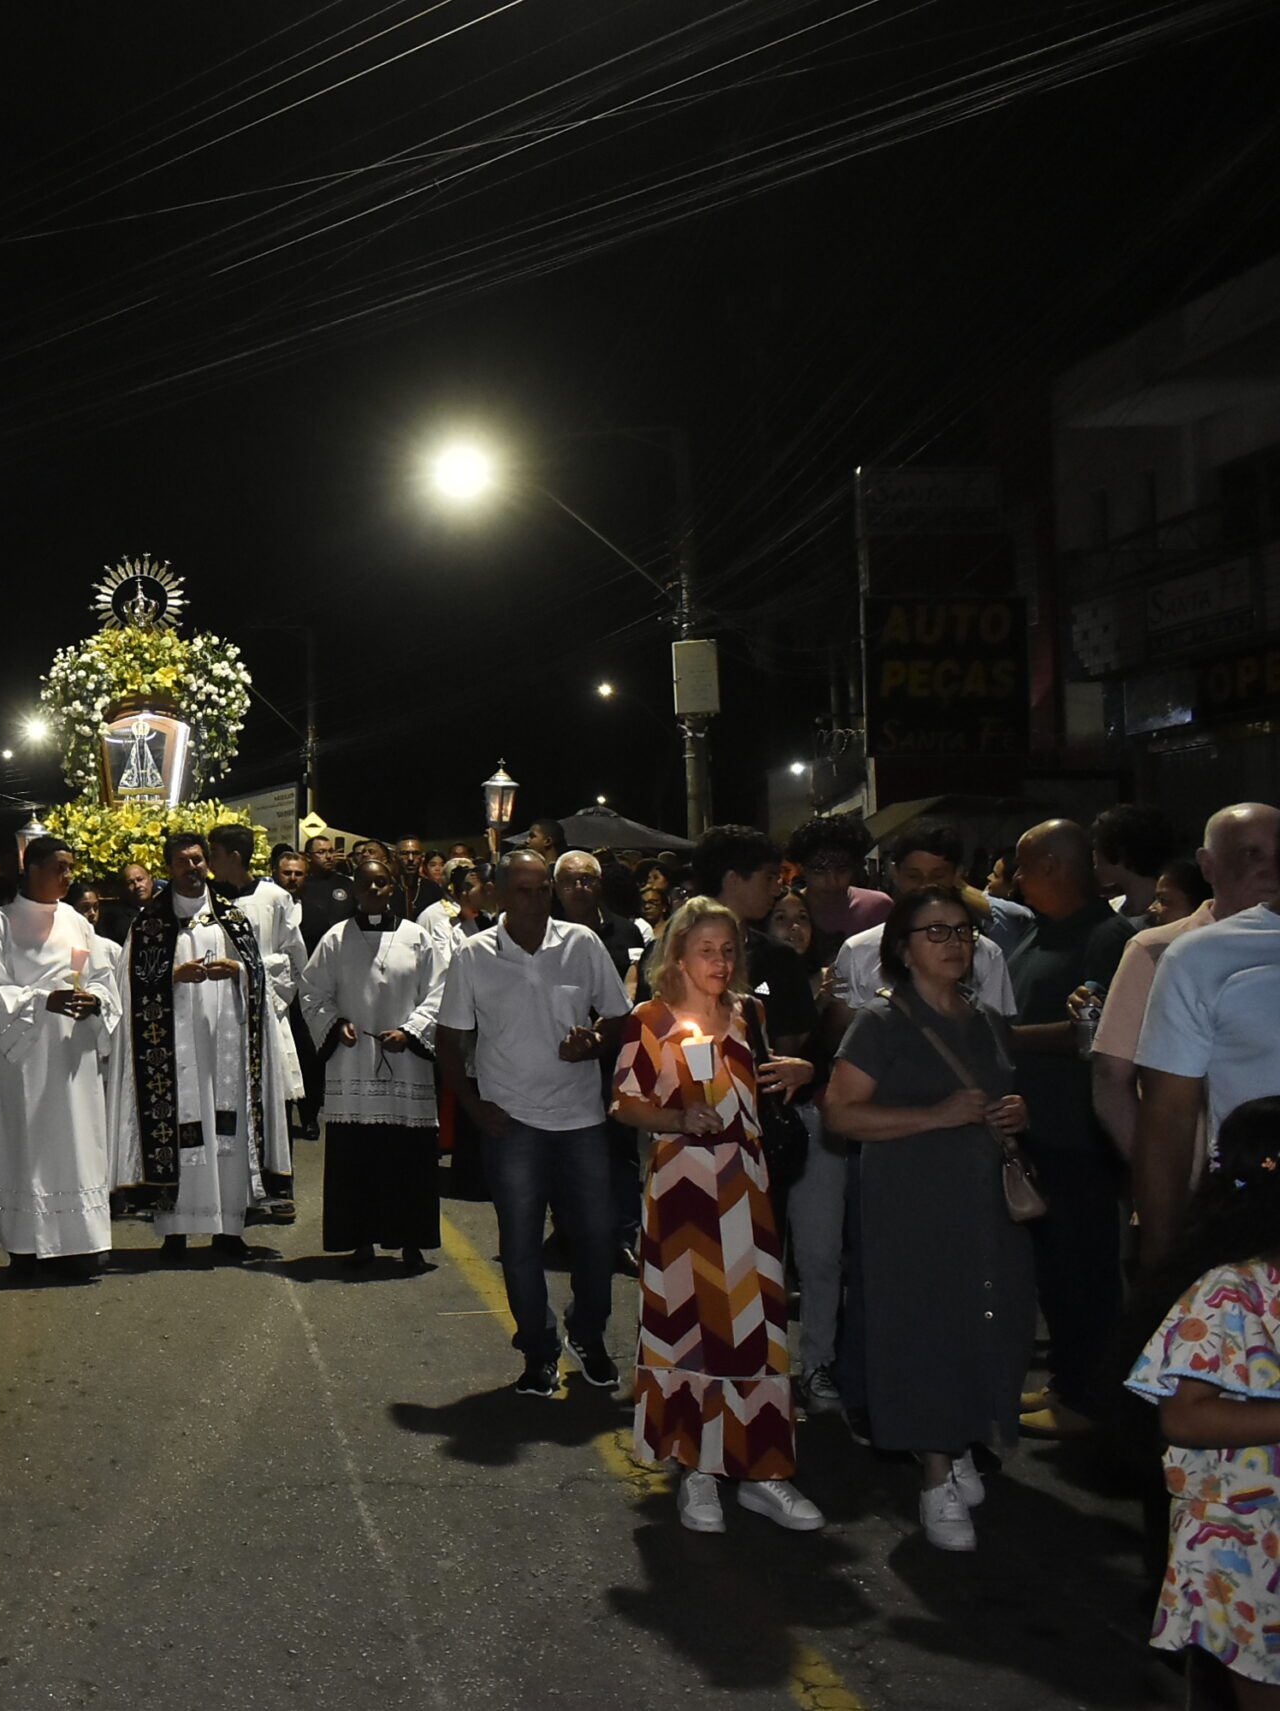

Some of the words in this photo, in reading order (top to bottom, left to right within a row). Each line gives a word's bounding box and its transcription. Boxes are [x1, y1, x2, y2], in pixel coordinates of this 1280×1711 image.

[879, 603, 1011, 644] AUTO
[878, 659, 1016, 710] PEÇAS
[876, 718, 966, 752] SANTA
